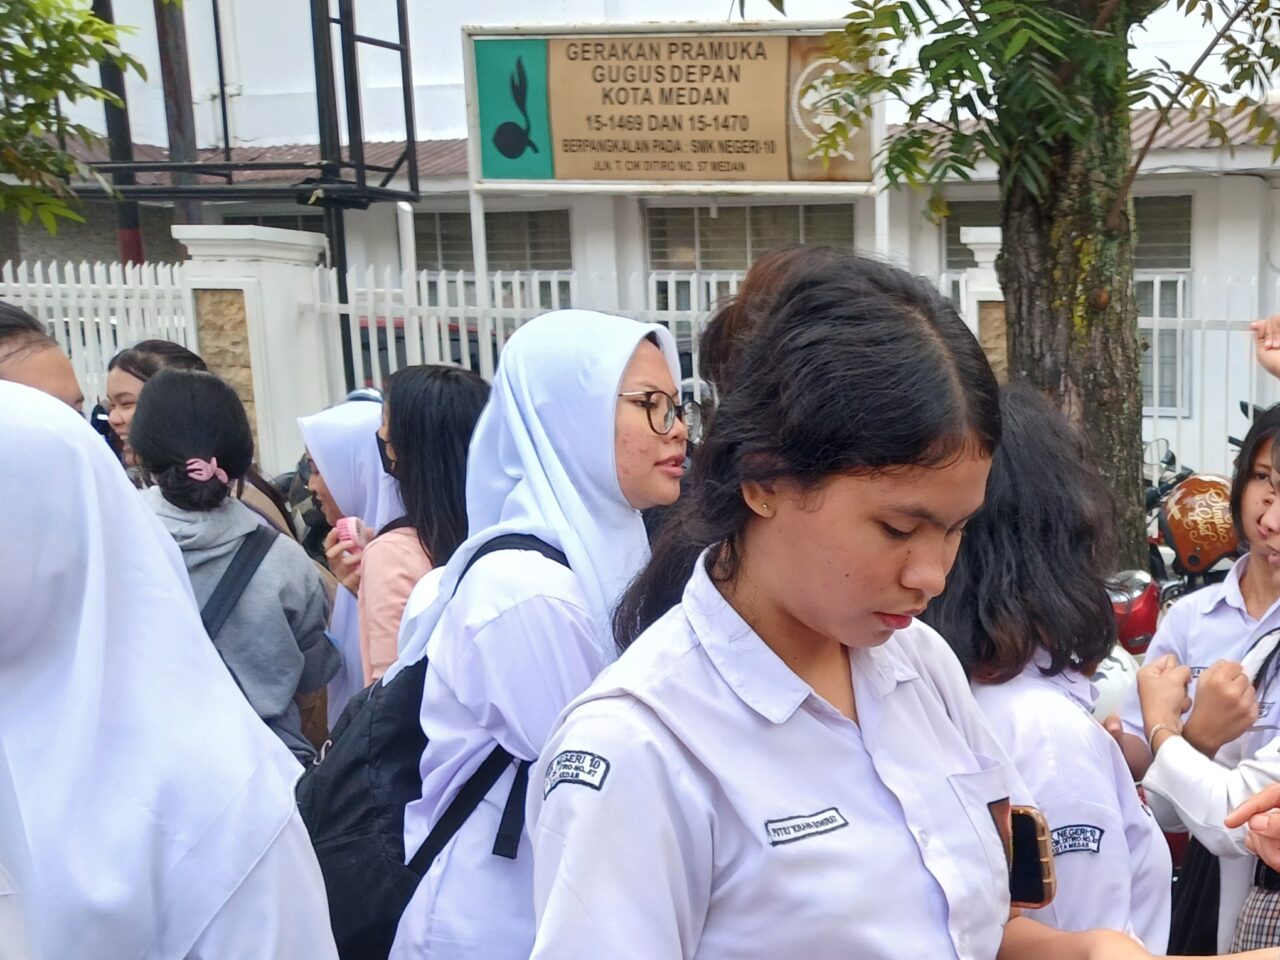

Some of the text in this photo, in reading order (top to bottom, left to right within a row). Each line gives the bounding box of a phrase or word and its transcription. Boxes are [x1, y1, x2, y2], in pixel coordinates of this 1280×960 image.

[566, 41, 768, 61] GERAKAN PRAMUKA
[601, 87, 730, 106] KOTA MEDAN
[586, 114, 749, 132] 15-1469 DAN 15-1470
[562, 138, 652, 153] BERPANGKALAN
[690, 138, 716, 153] SMK
